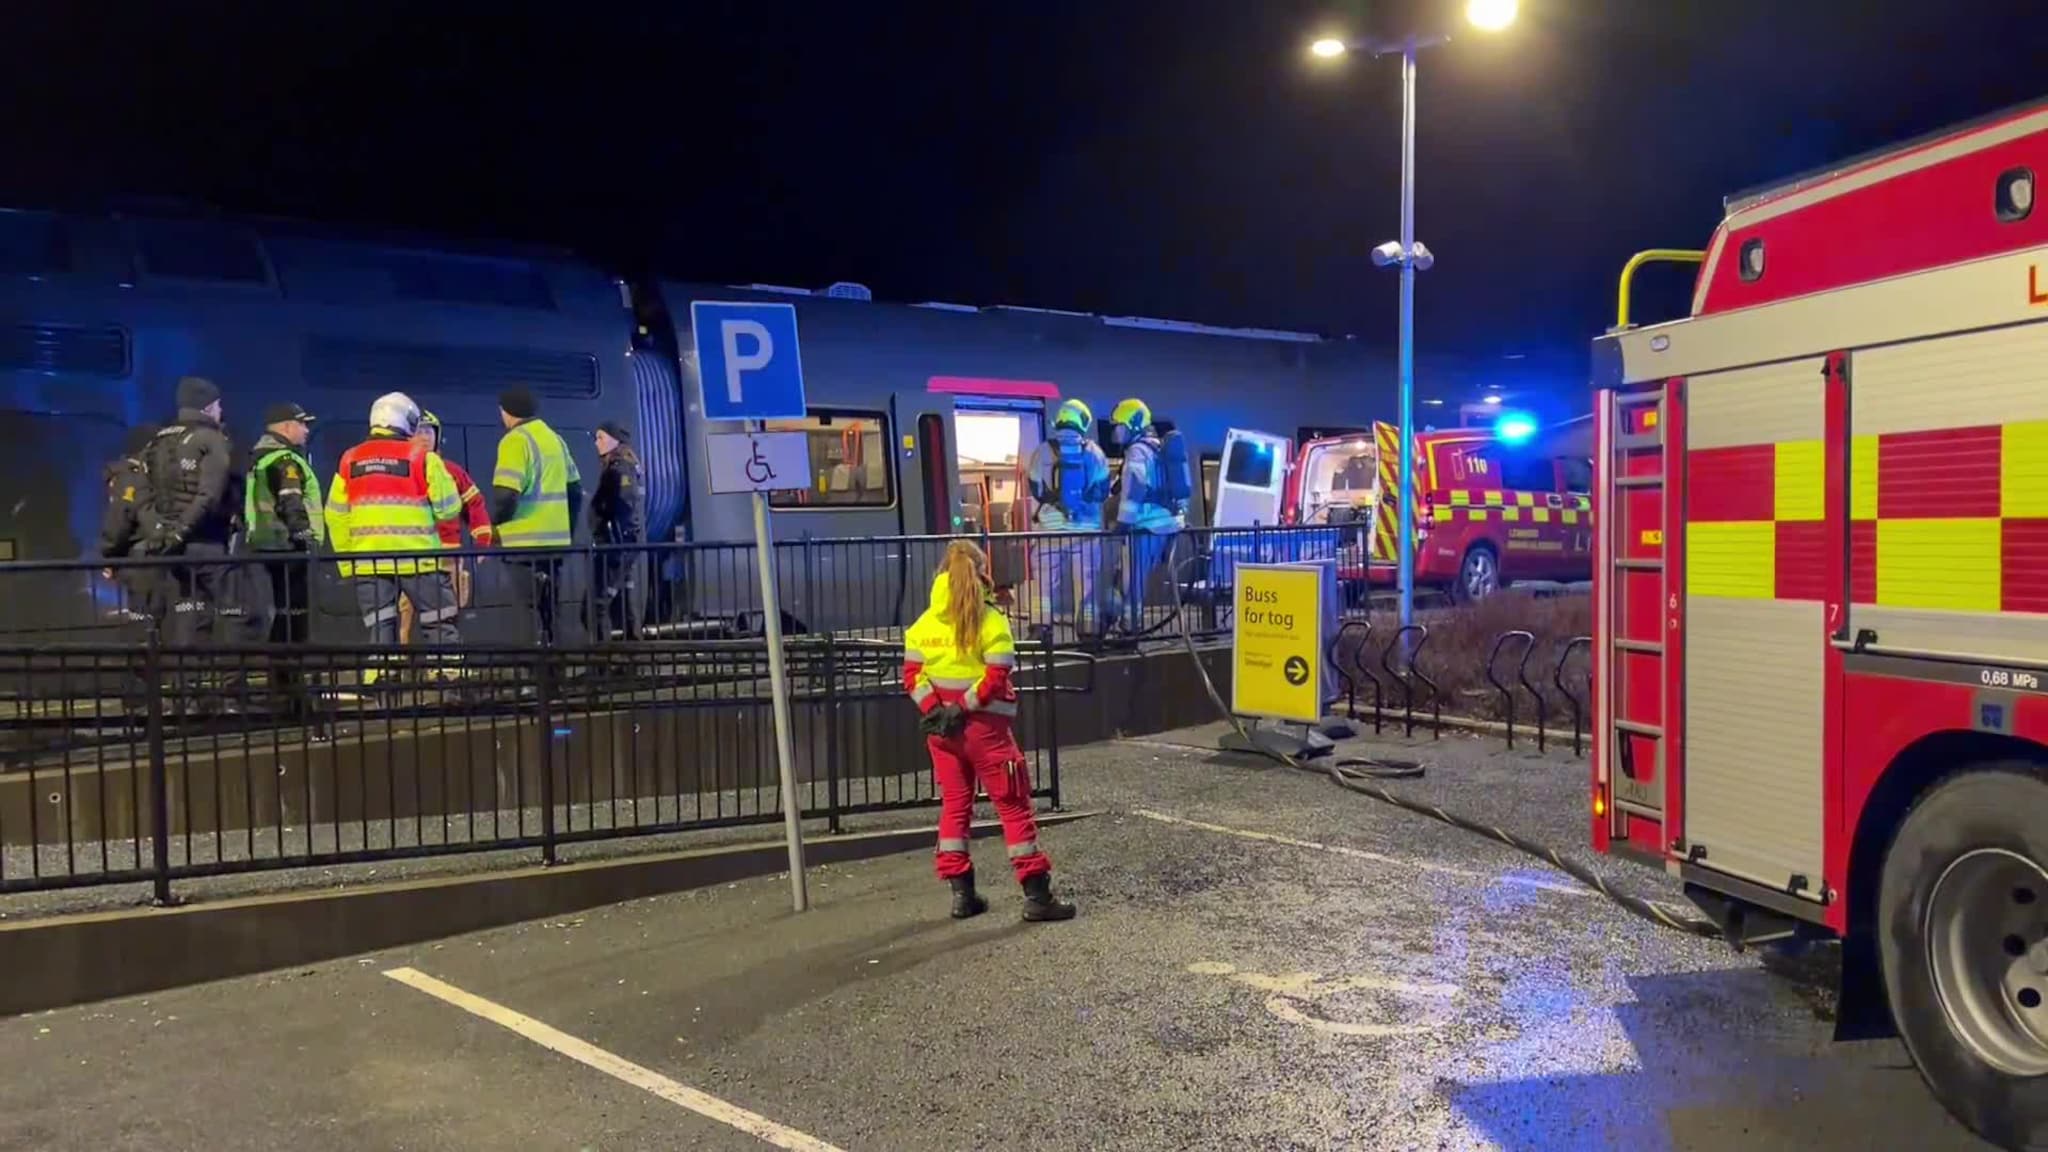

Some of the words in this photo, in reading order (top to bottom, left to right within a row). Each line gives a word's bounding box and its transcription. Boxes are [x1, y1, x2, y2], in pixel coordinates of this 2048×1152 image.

[721, 319, 774, 403] P
[1466, 456, 1488, 474] 110
[1245, 585, 1279, 603] Buss
[1669, 593, 1678, 609] 6
[1244, 606, 1265, 624] for
[1268, 610, 1294, 631] tog
[1829, 603, 1840, 622] 7
[1981, 670, 2009, 686] 0,68
[2012, 672, 2038, 689] MPa
